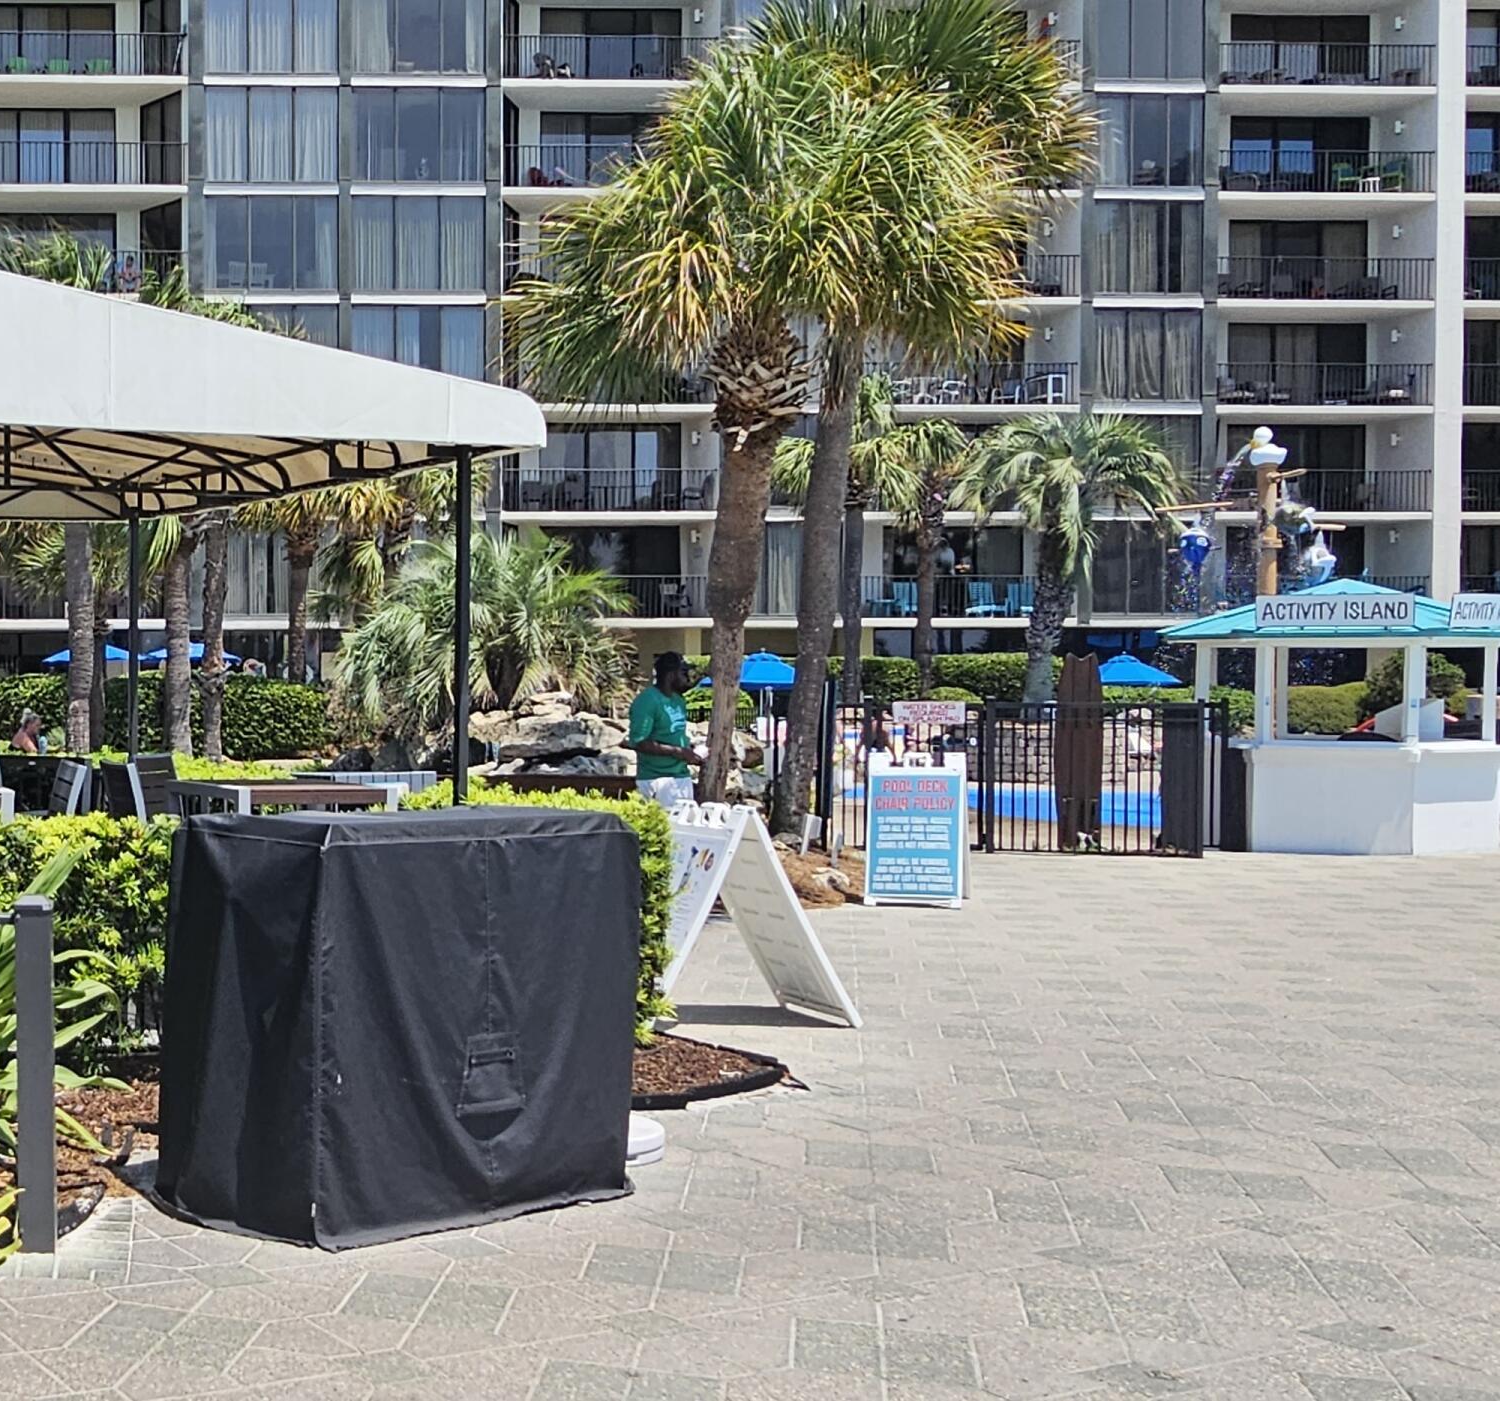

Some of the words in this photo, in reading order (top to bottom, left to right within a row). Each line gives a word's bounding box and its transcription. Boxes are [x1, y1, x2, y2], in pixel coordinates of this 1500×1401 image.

[1261, 602, 1337, 621] ACTIVITY
[1344, 601, 1409, 620] ISLAND
[1454, 601, 1496, 620] ACTIVITY
[882, 779, 913, 793] POOL
[917, 779, 948, 793] DECK
[875, 798, 910, 811] CHAIR
[913, 798, 955, 811] POLICY
